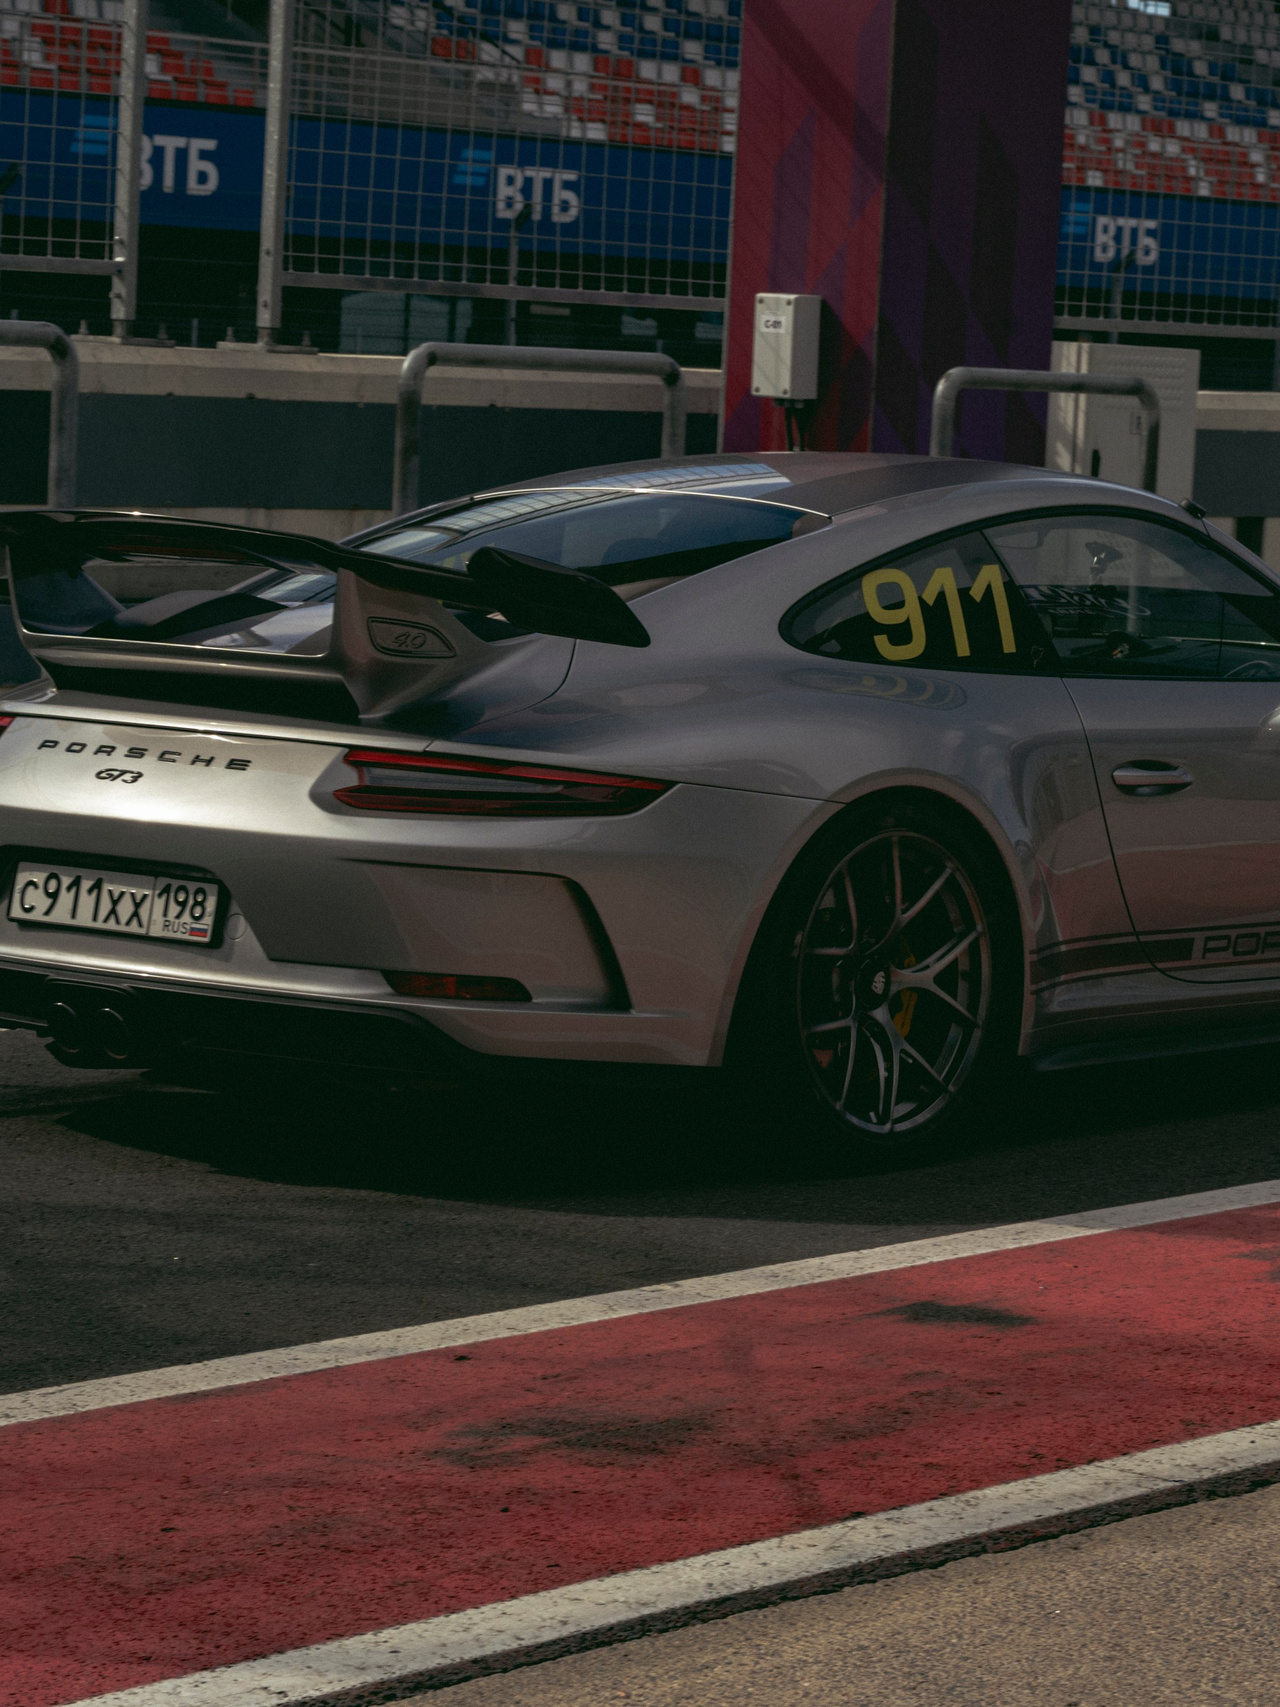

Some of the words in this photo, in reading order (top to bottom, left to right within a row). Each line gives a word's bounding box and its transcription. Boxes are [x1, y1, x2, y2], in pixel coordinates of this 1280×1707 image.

[495, 164, 580, 224] ВТБ
[1093, 215, 1160, 267] ВТБ
[861, 564, 1017, 661] 911
[392, 631, 427, 649] 4.0
[38, 740, 252, 771] PORSCHE
[95, 768, 144, 783] GT3
[158, 882, 208, 921] 198
[162, 919, 189, 935] RUS
